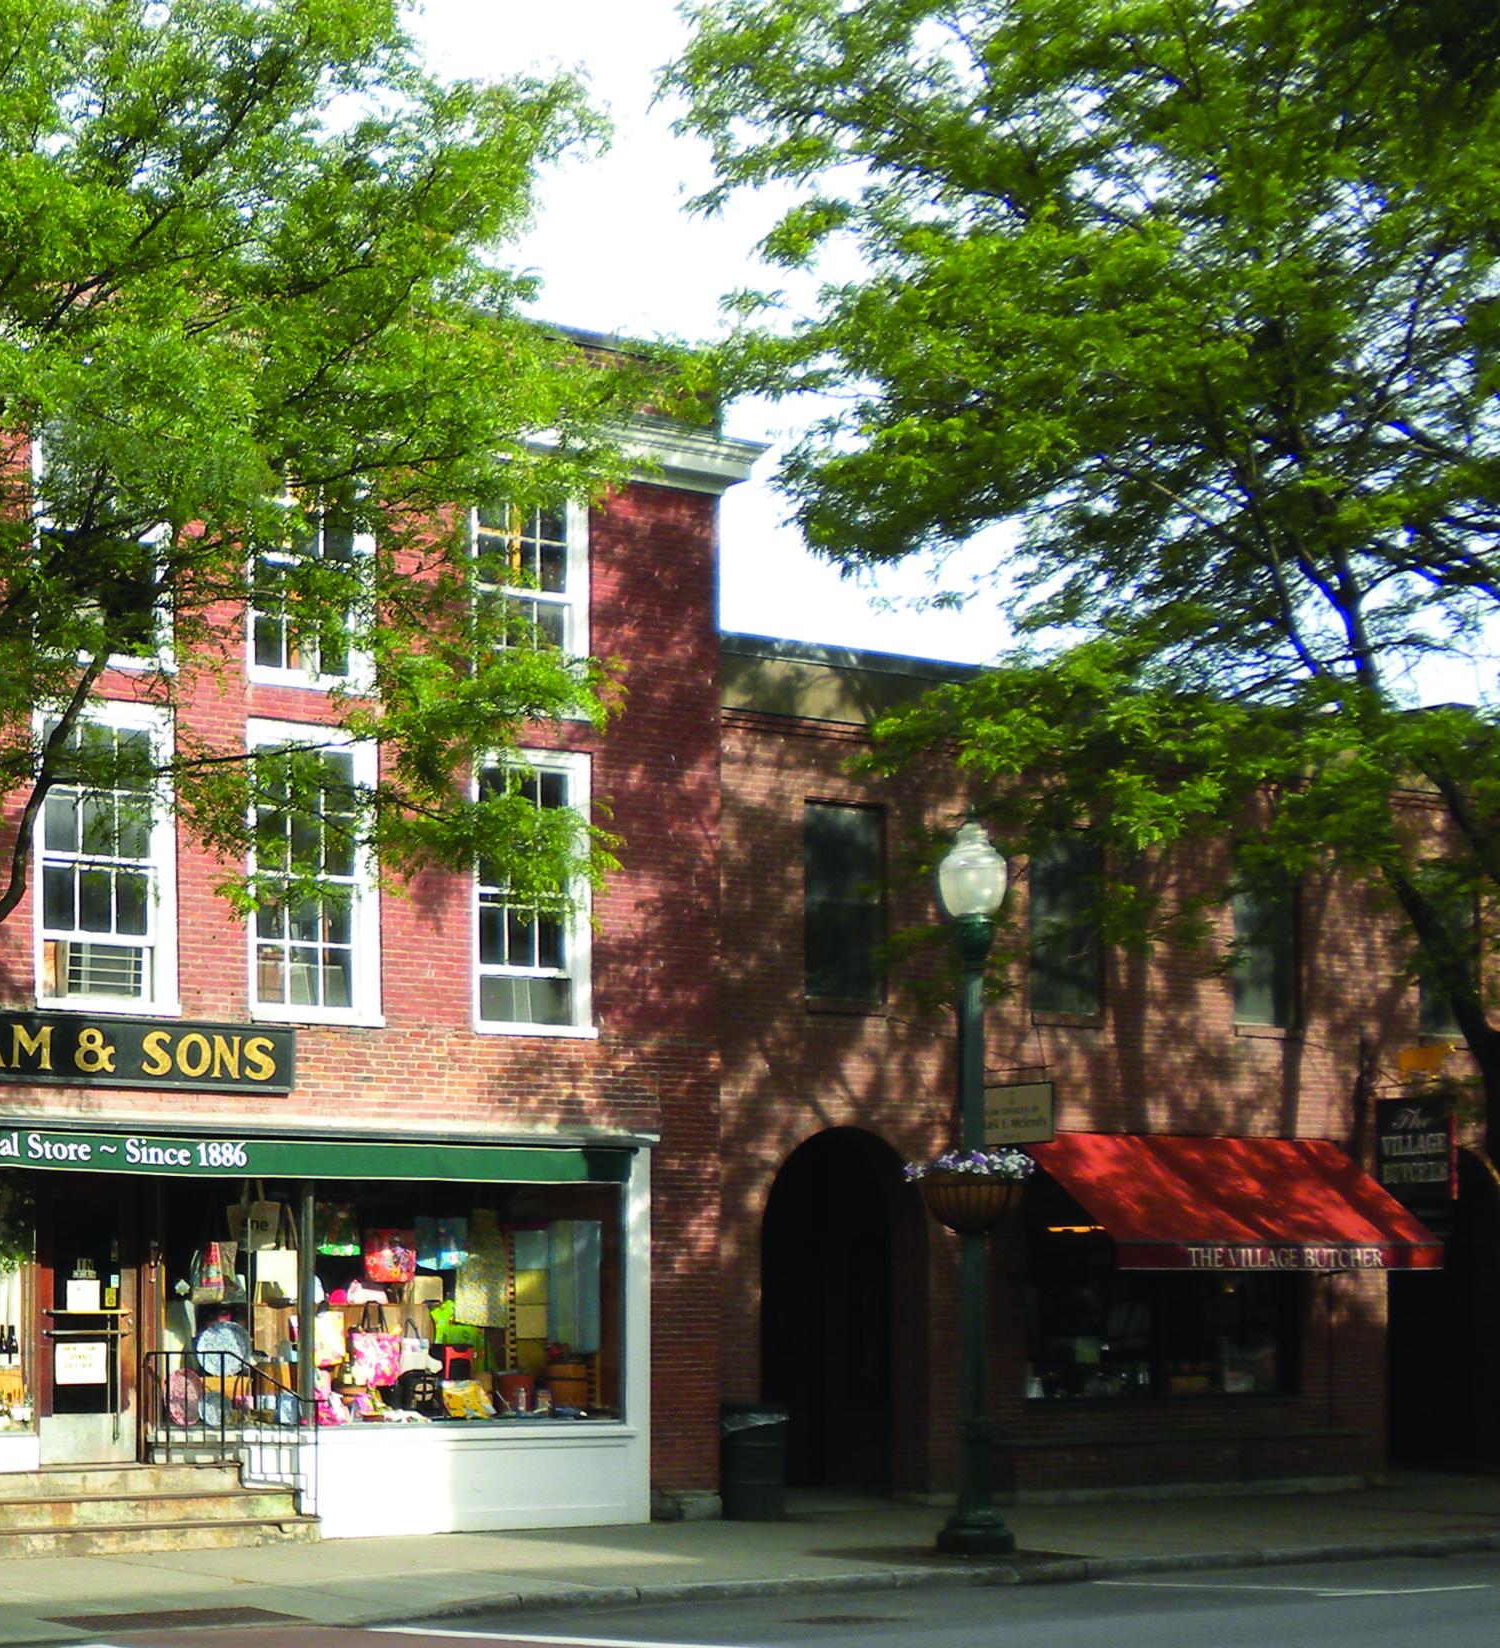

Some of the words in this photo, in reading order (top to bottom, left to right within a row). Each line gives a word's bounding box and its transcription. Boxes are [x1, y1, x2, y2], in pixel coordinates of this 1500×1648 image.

[74, 1028, 116, 1073] &
[141, 1030, 276, 1081] SONS
[27, 1133, 91, 1161] Store
[125, 1138, 191, 1166] Since
[196, 1142, 247, 1167] 1886
[1381, 1133, 1446, 1156] VILLAGE
[1187, 1247, 1223, 1267] THE
[1226, 1247, 1298, 1267] VILLAGE
[1303, 1247, 1384, 1267] BUTCHER
